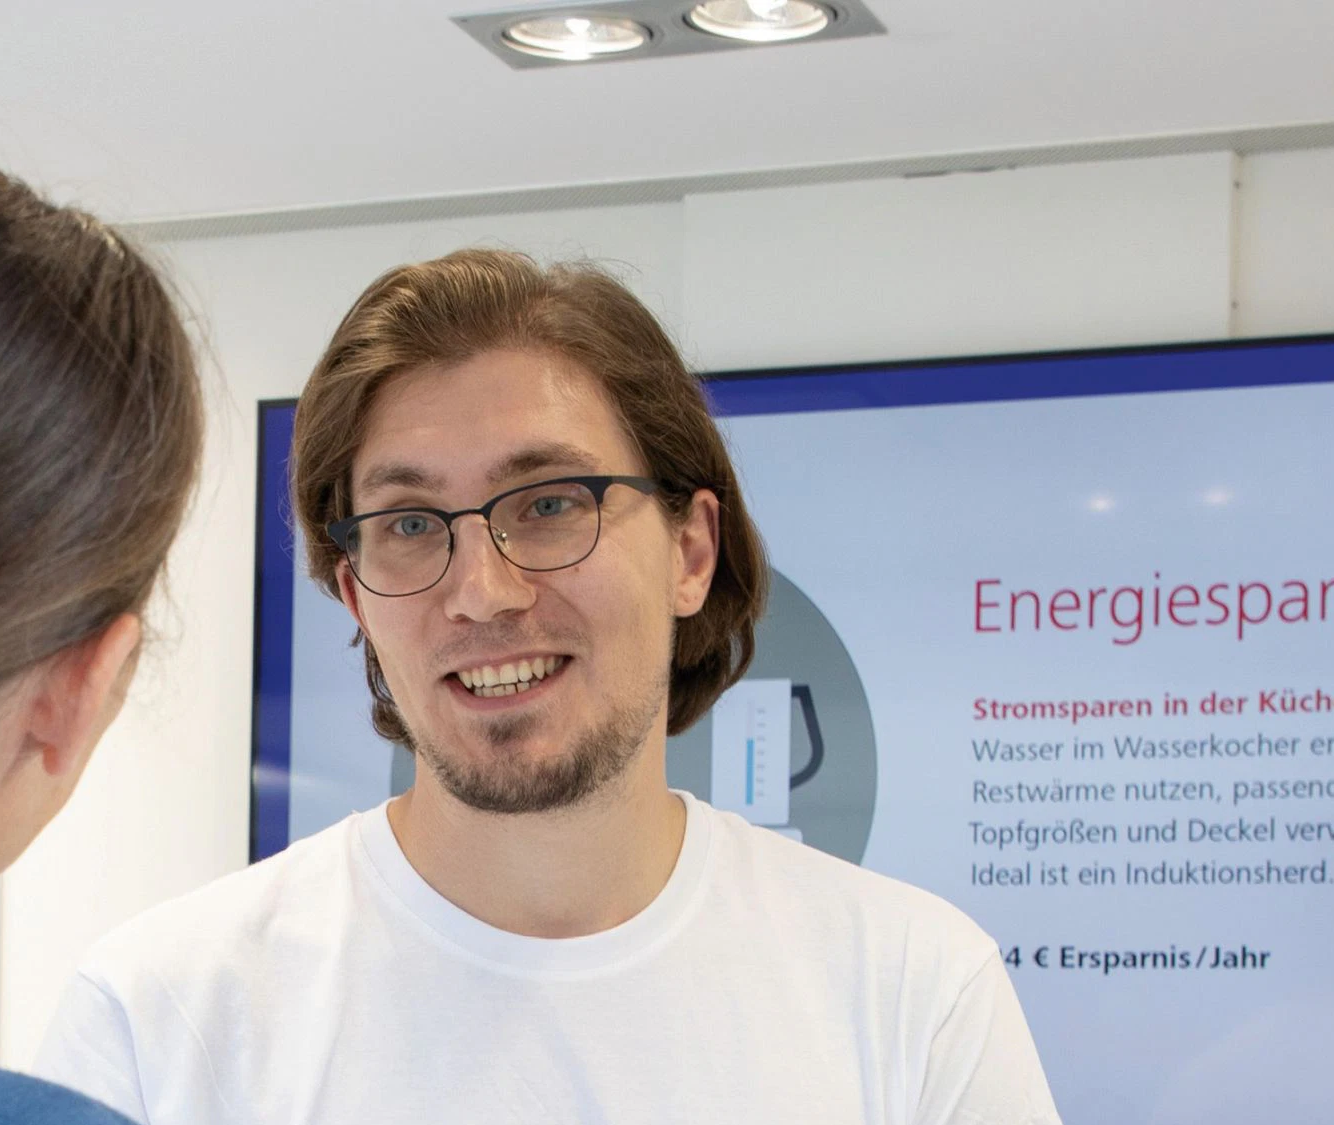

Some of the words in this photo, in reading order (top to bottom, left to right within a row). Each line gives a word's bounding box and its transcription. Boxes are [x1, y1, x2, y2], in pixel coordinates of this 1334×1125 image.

[972, 697, 1153, 726] Stromsparen
[1162, 691, 1189, 717] in
[1198, 690, 1249, 716] der
[970, 738, 1064, 763] Wasser
[1072, 736, 1105, 761] im
[1113, 732, 1301, 760] Wasserkocher
[971, 777, 1116, 804] Restwärme
[1123, 777, 1223, 805] nutzen,
[968, 817, 1118, 852] Topfgrößen
[1127, 818, 1178, 844] und
[1187, 816, 1276, 843] Deckel
[970, 861, 1031, 887] Ideal
[1040, 861, 1069, 887] ist
[1077, 861, 1117, 887] ein
[1125, 858, 1334, 886] Induktionsherd.
[1000, 944, 1022, 970] 4
[1032, 945, 1050, 970] €
